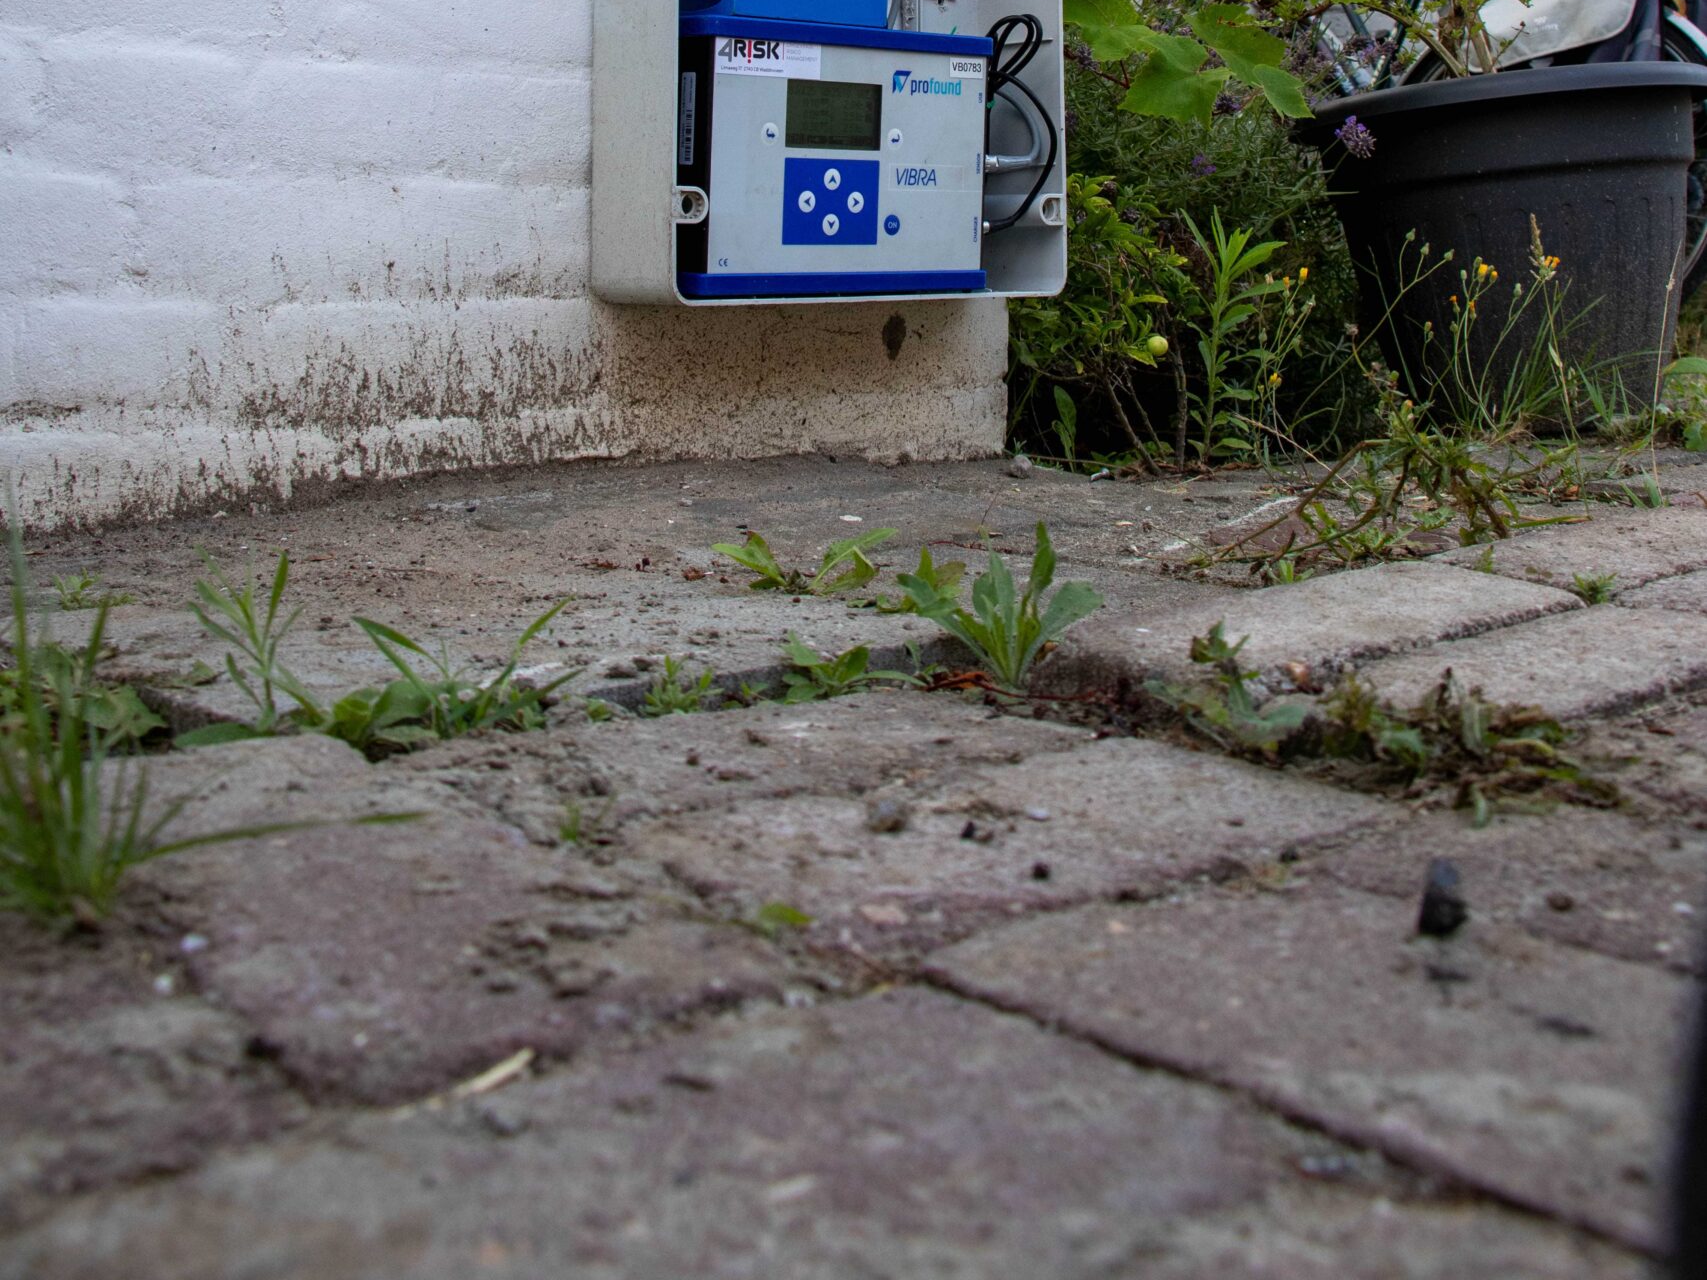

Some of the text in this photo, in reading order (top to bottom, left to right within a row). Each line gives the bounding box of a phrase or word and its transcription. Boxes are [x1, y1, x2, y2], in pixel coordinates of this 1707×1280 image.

[952, 62, 982, 73] VB0783
[911, 77, 962, 96] profound
[895, 167, 937, 187] VIBRA
[887, 221, 898, 230] ON
